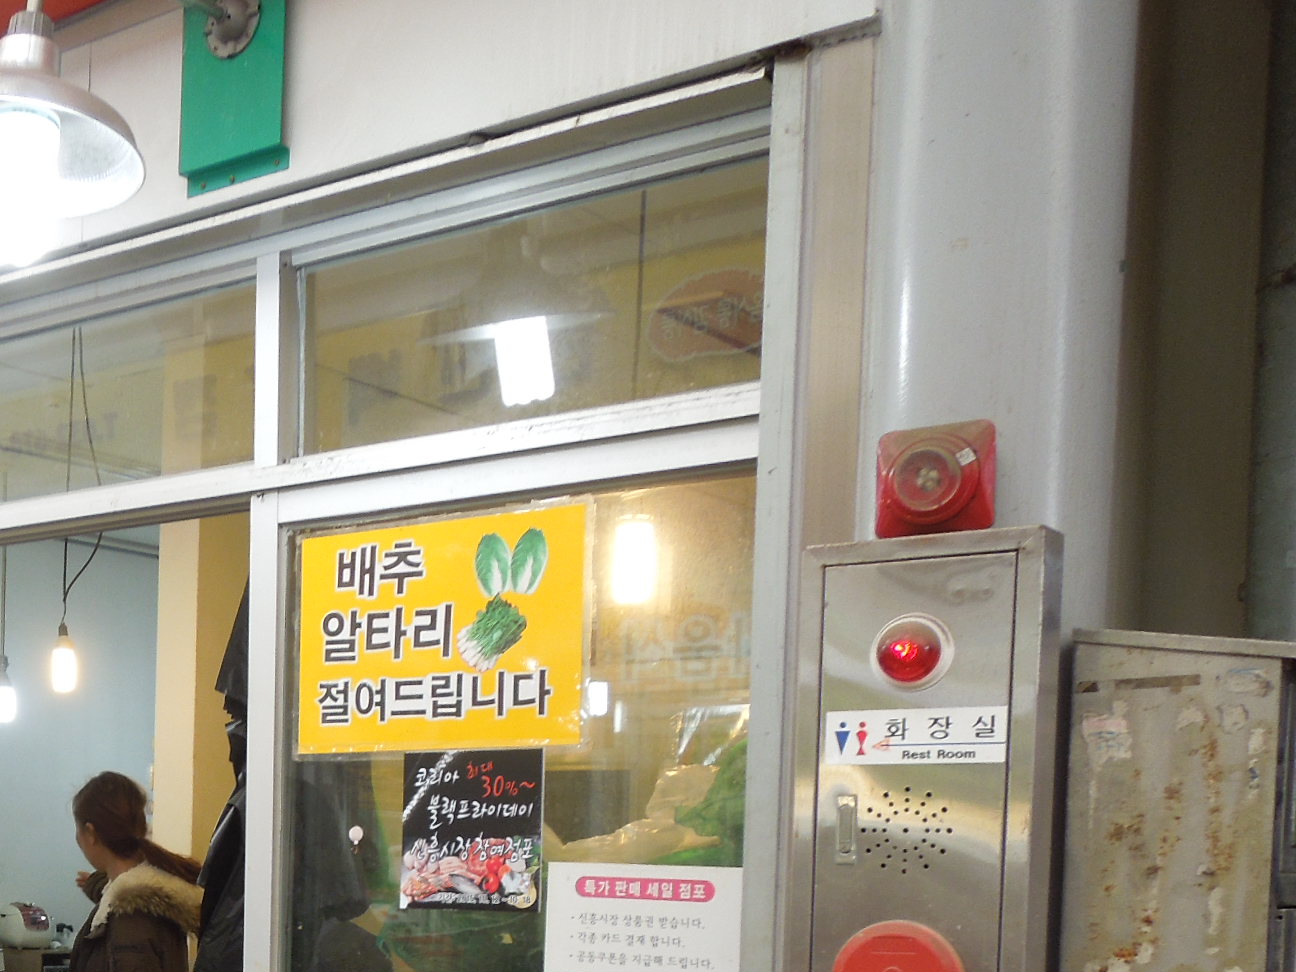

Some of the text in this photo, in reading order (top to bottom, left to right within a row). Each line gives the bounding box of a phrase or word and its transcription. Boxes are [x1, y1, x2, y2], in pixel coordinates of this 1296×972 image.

[336, 541, 425, 597] 배추
[321, 602, 454, 663] 알타리
[316, 668, 552, 725] 절여드립니다
[884, 714, 996, 741] 화장실
[902, 749, 976, 760] Rest Room
[414, 767, 460, 788] 코리아
[584, 880, 707, 899] 특가 판매 세일 점포
